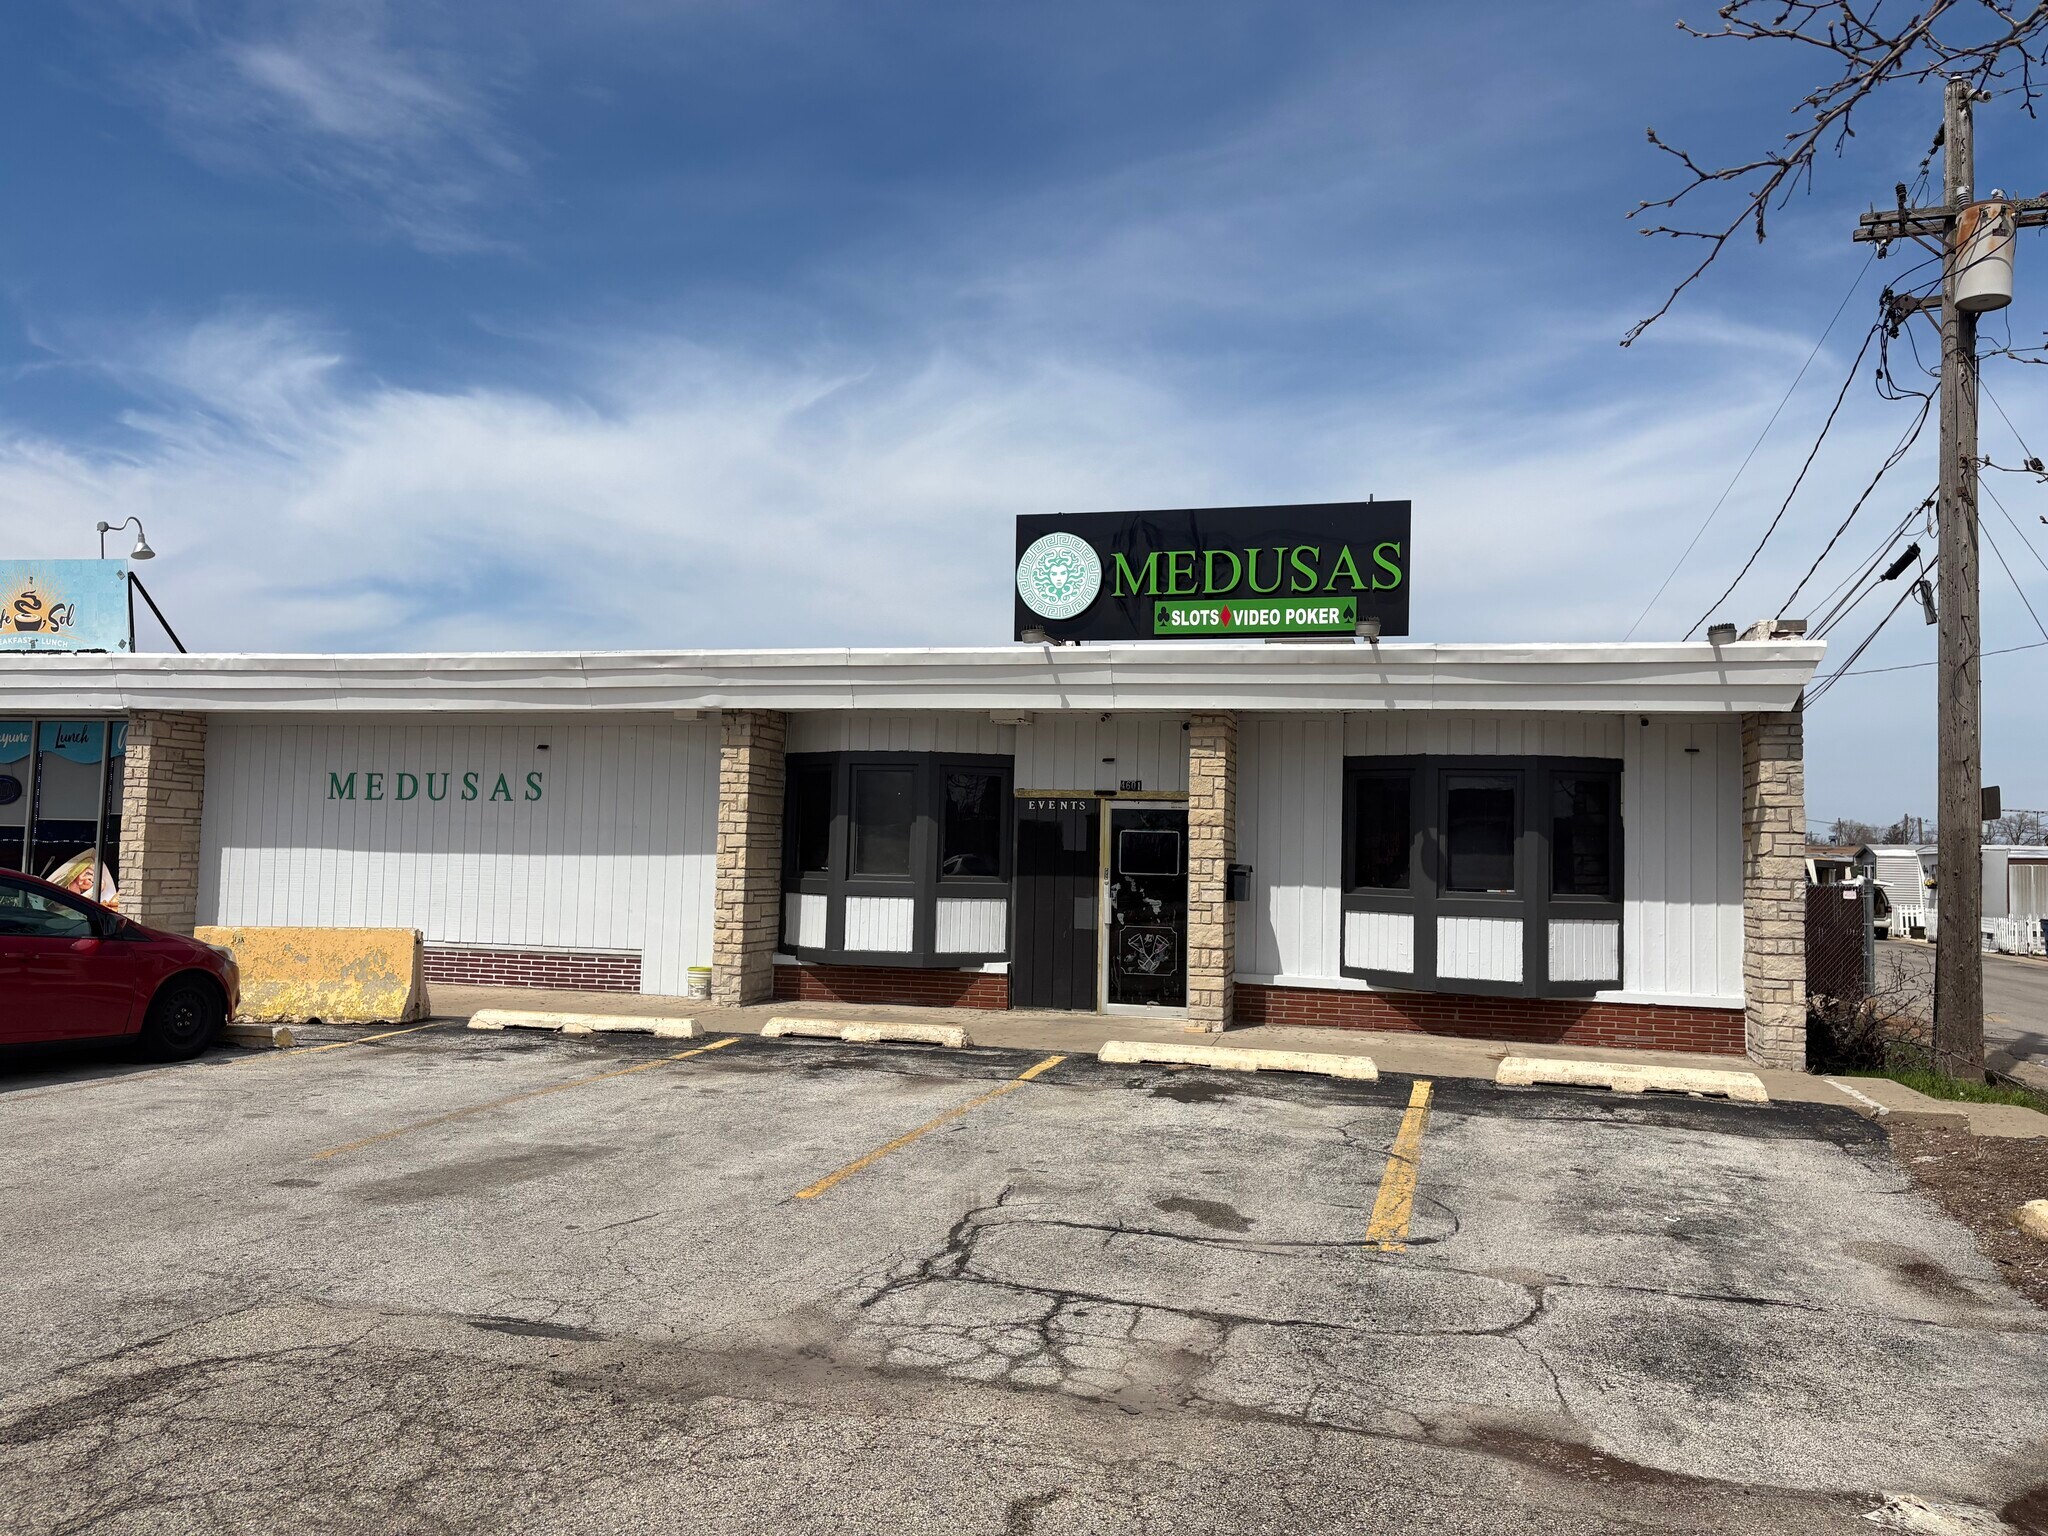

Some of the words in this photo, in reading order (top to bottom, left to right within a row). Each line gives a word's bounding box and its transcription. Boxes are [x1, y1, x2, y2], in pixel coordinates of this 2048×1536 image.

[1110, 541, 1402, 597] MEDUSAS
[48, 603, 75, 632] Sol
[1171, 609, 1220, 626] SLOTS
[1233, 609, 1281, 626] VIDEO
[1285, 607, 1340, 625] POKER
[41, 637, 68, 648] LUNCH
[0, 732, 30, 748] yuno
[55, 723, 89, 749] Lunch
[327, 771, 543, 802] MEDUSAS
[1120, 780, 1142, 792] 4601
[1028, 800, 1087, 810] EVENTS
